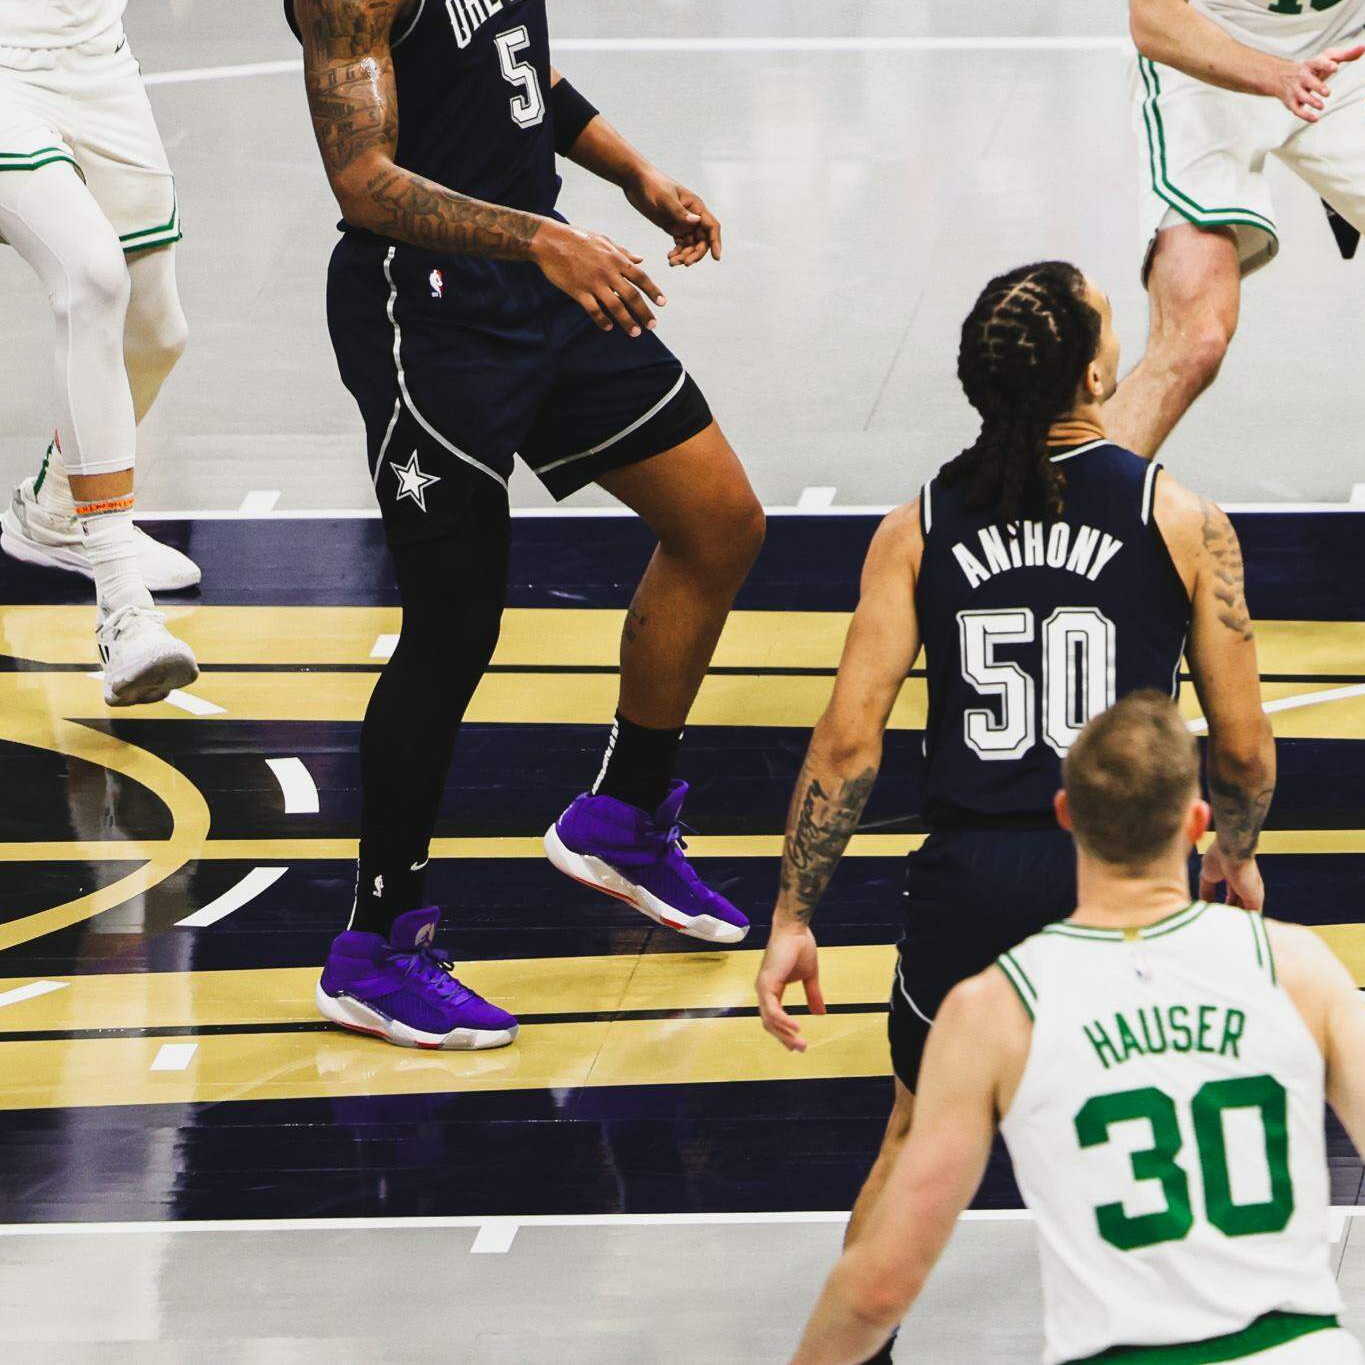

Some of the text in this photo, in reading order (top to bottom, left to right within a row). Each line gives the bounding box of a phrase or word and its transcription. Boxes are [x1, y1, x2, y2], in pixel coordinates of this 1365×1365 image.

[494, 25, 546, 129] 5
[951, 520, 1124, 589] ANTHONY
[956, 606, 1116, 761] 50
[1083, 1005, 1245, 1069] HAUSER
[1073, 1074, 1295, 1252] 30
